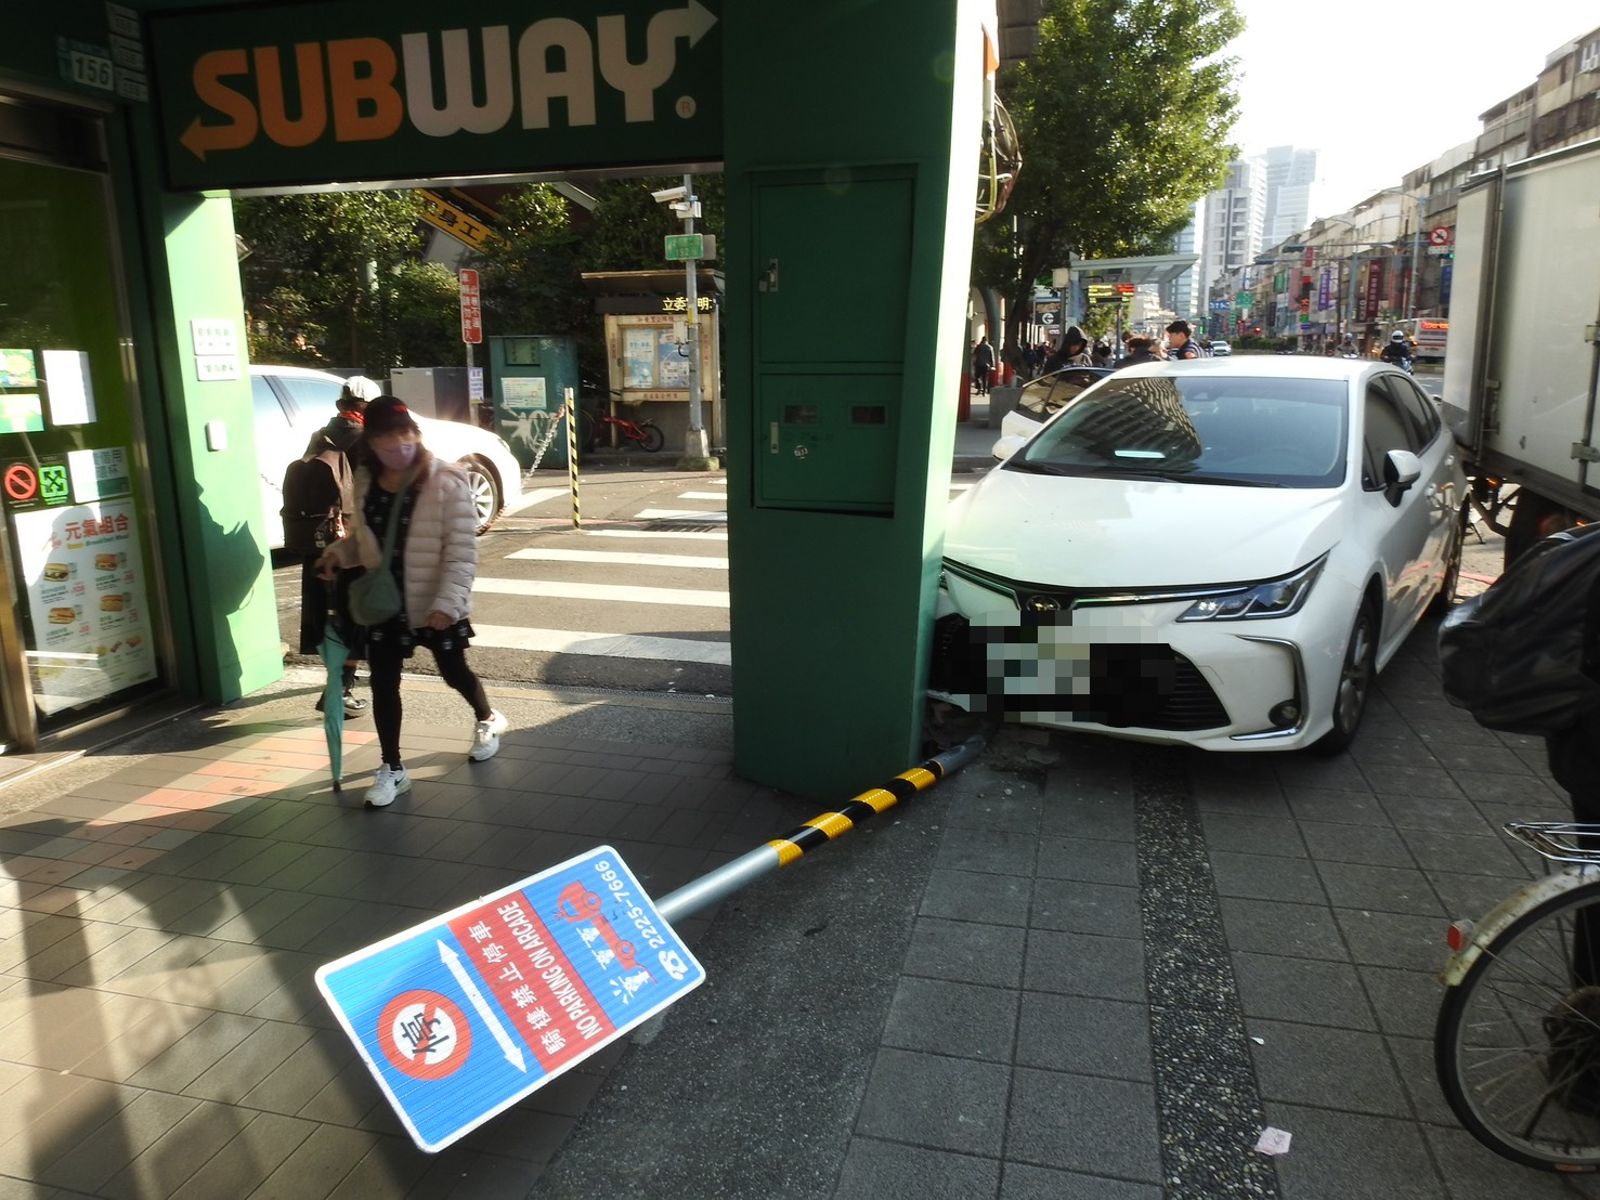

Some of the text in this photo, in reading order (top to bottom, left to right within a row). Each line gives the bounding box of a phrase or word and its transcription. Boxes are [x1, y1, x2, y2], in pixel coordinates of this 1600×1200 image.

[75, 57, 112, 87] 156
[179, 0, 719, 162] SUBWAY
[64, 512, 129, 541] 元氣組合
[595, 860, 666, 949] 2225-7666
[467, 920, 567, 1055] 騎樓禁止停車
[496, 900, 603, 1041] NO PARKING ON ARCADE
[400, 1011, 450, 1059] 停
